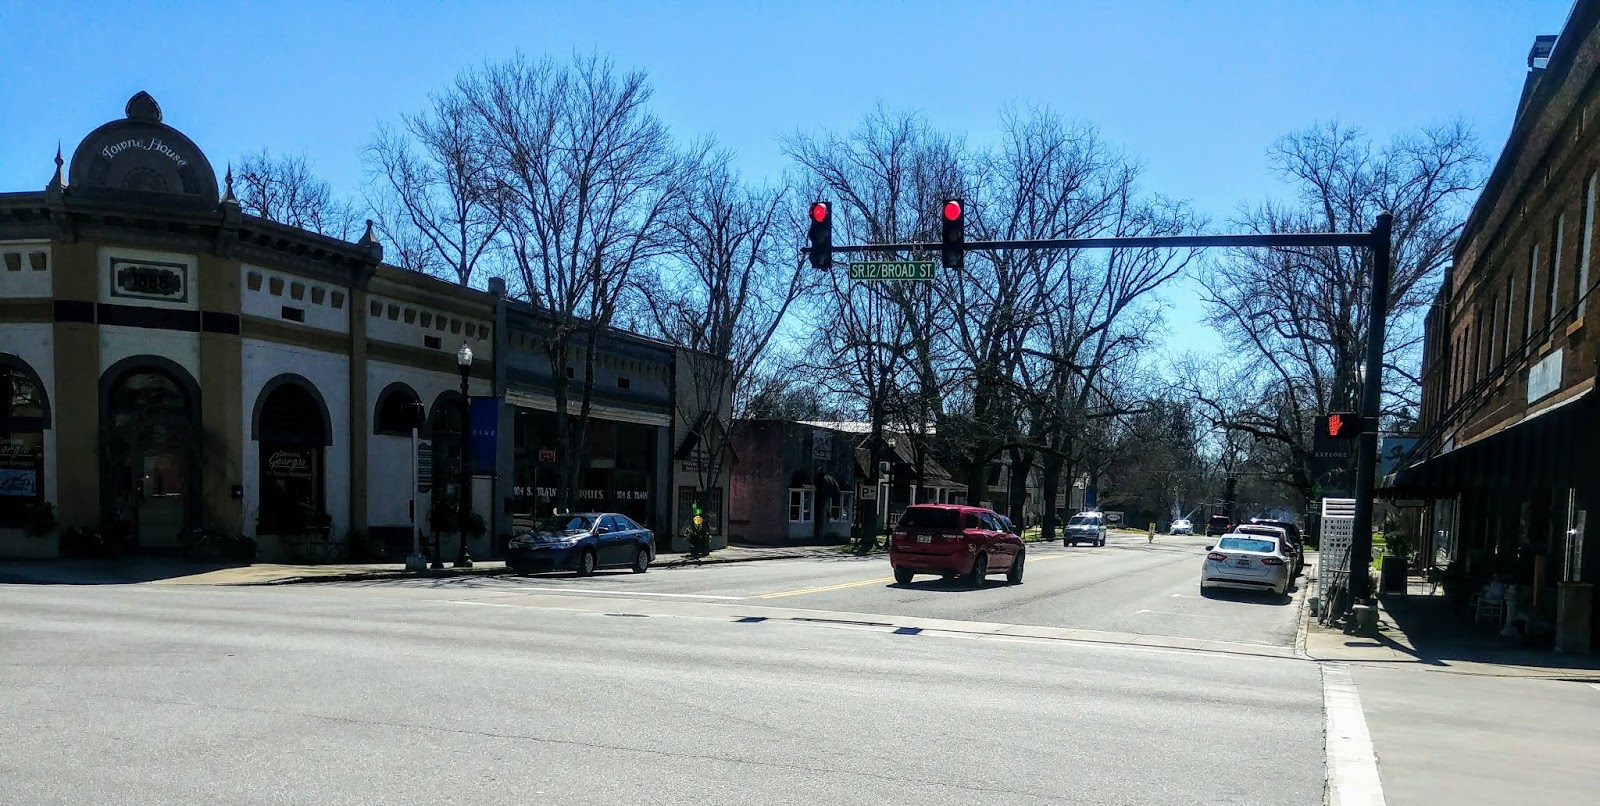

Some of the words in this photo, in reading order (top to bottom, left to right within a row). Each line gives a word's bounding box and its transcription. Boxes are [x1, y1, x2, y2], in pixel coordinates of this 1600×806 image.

[102, 139, 144, 159] Towne
[143, 138, 188, 166] House
[919, 264, 934, 278] ST.
[268, 452, 307, 471] Georgia
[862, 488, 869, 498] P
